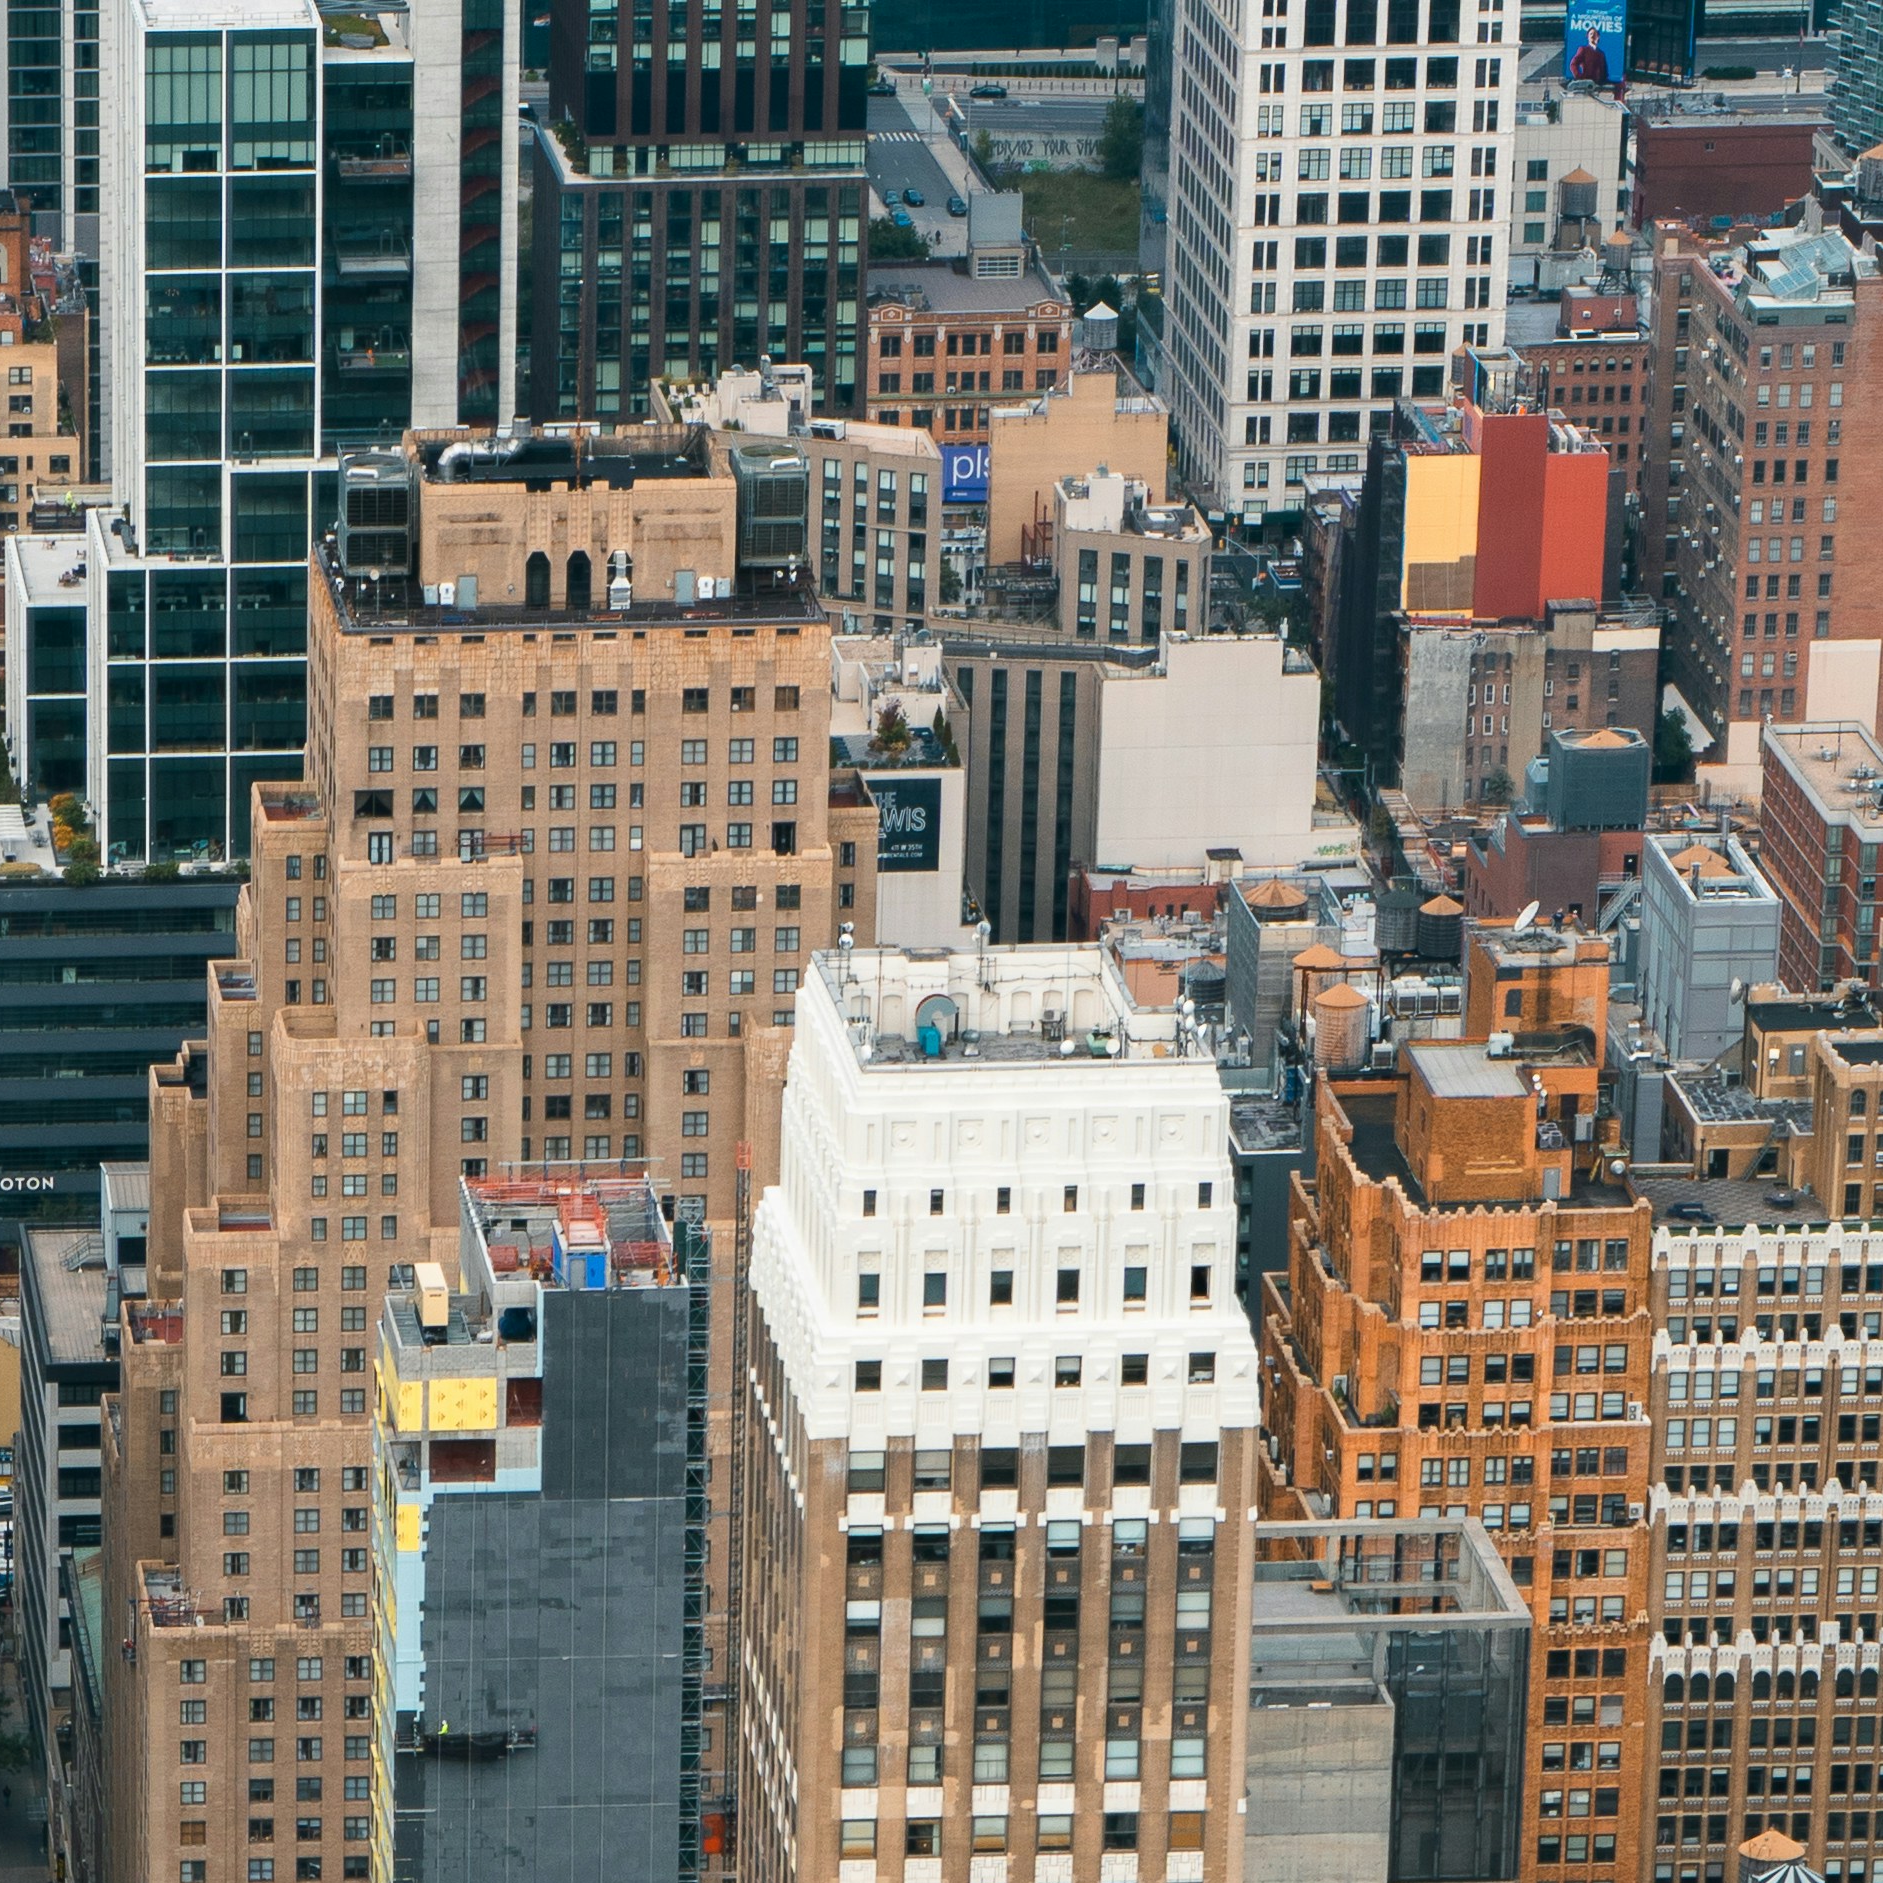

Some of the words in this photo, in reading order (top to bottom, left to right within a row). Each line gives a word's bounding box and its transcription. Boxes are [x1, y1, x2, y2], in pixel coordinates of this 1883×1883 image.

[1577, 13, 1613, 21] MOUNTAIN
[1570, 19, 1623, 33] MOVIES
[880, 806, 926, 836] WIS
